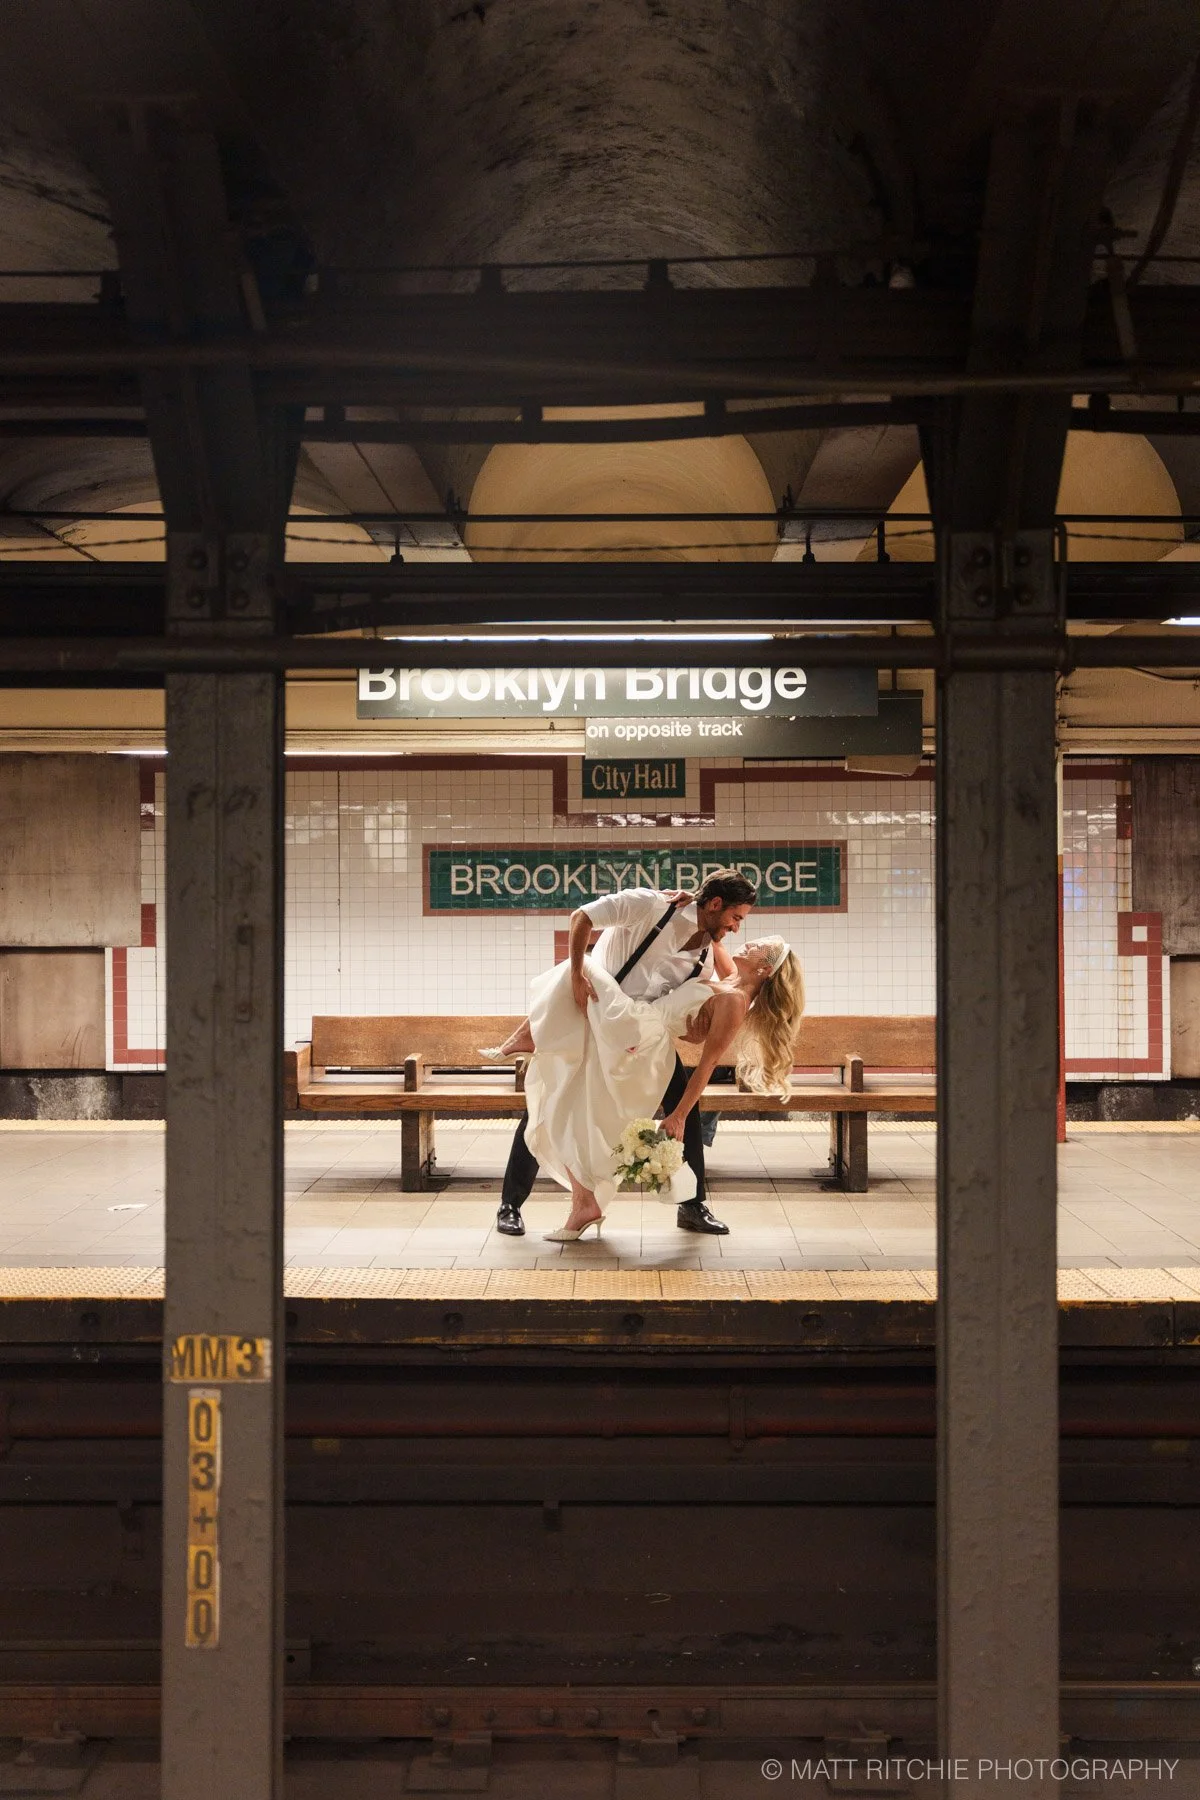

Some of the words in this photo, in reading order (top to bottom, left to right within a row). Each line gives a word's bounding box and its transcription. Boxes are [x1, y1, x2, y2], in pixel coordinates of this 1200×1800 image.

[358, 668, 606, 711] Brooklyn
[625, 668, 808, 711] Bridge
[586, 723, 609, 739] on
[614, 720, 692, 741] opposite
[699, 718, 743, 737] track
[591, 765, 630, 796] City
[634, 764, 677, 790] Hall
[450, 864, 661, 895] BROOKLYN
[677, 862, 818, 893] BDGE
